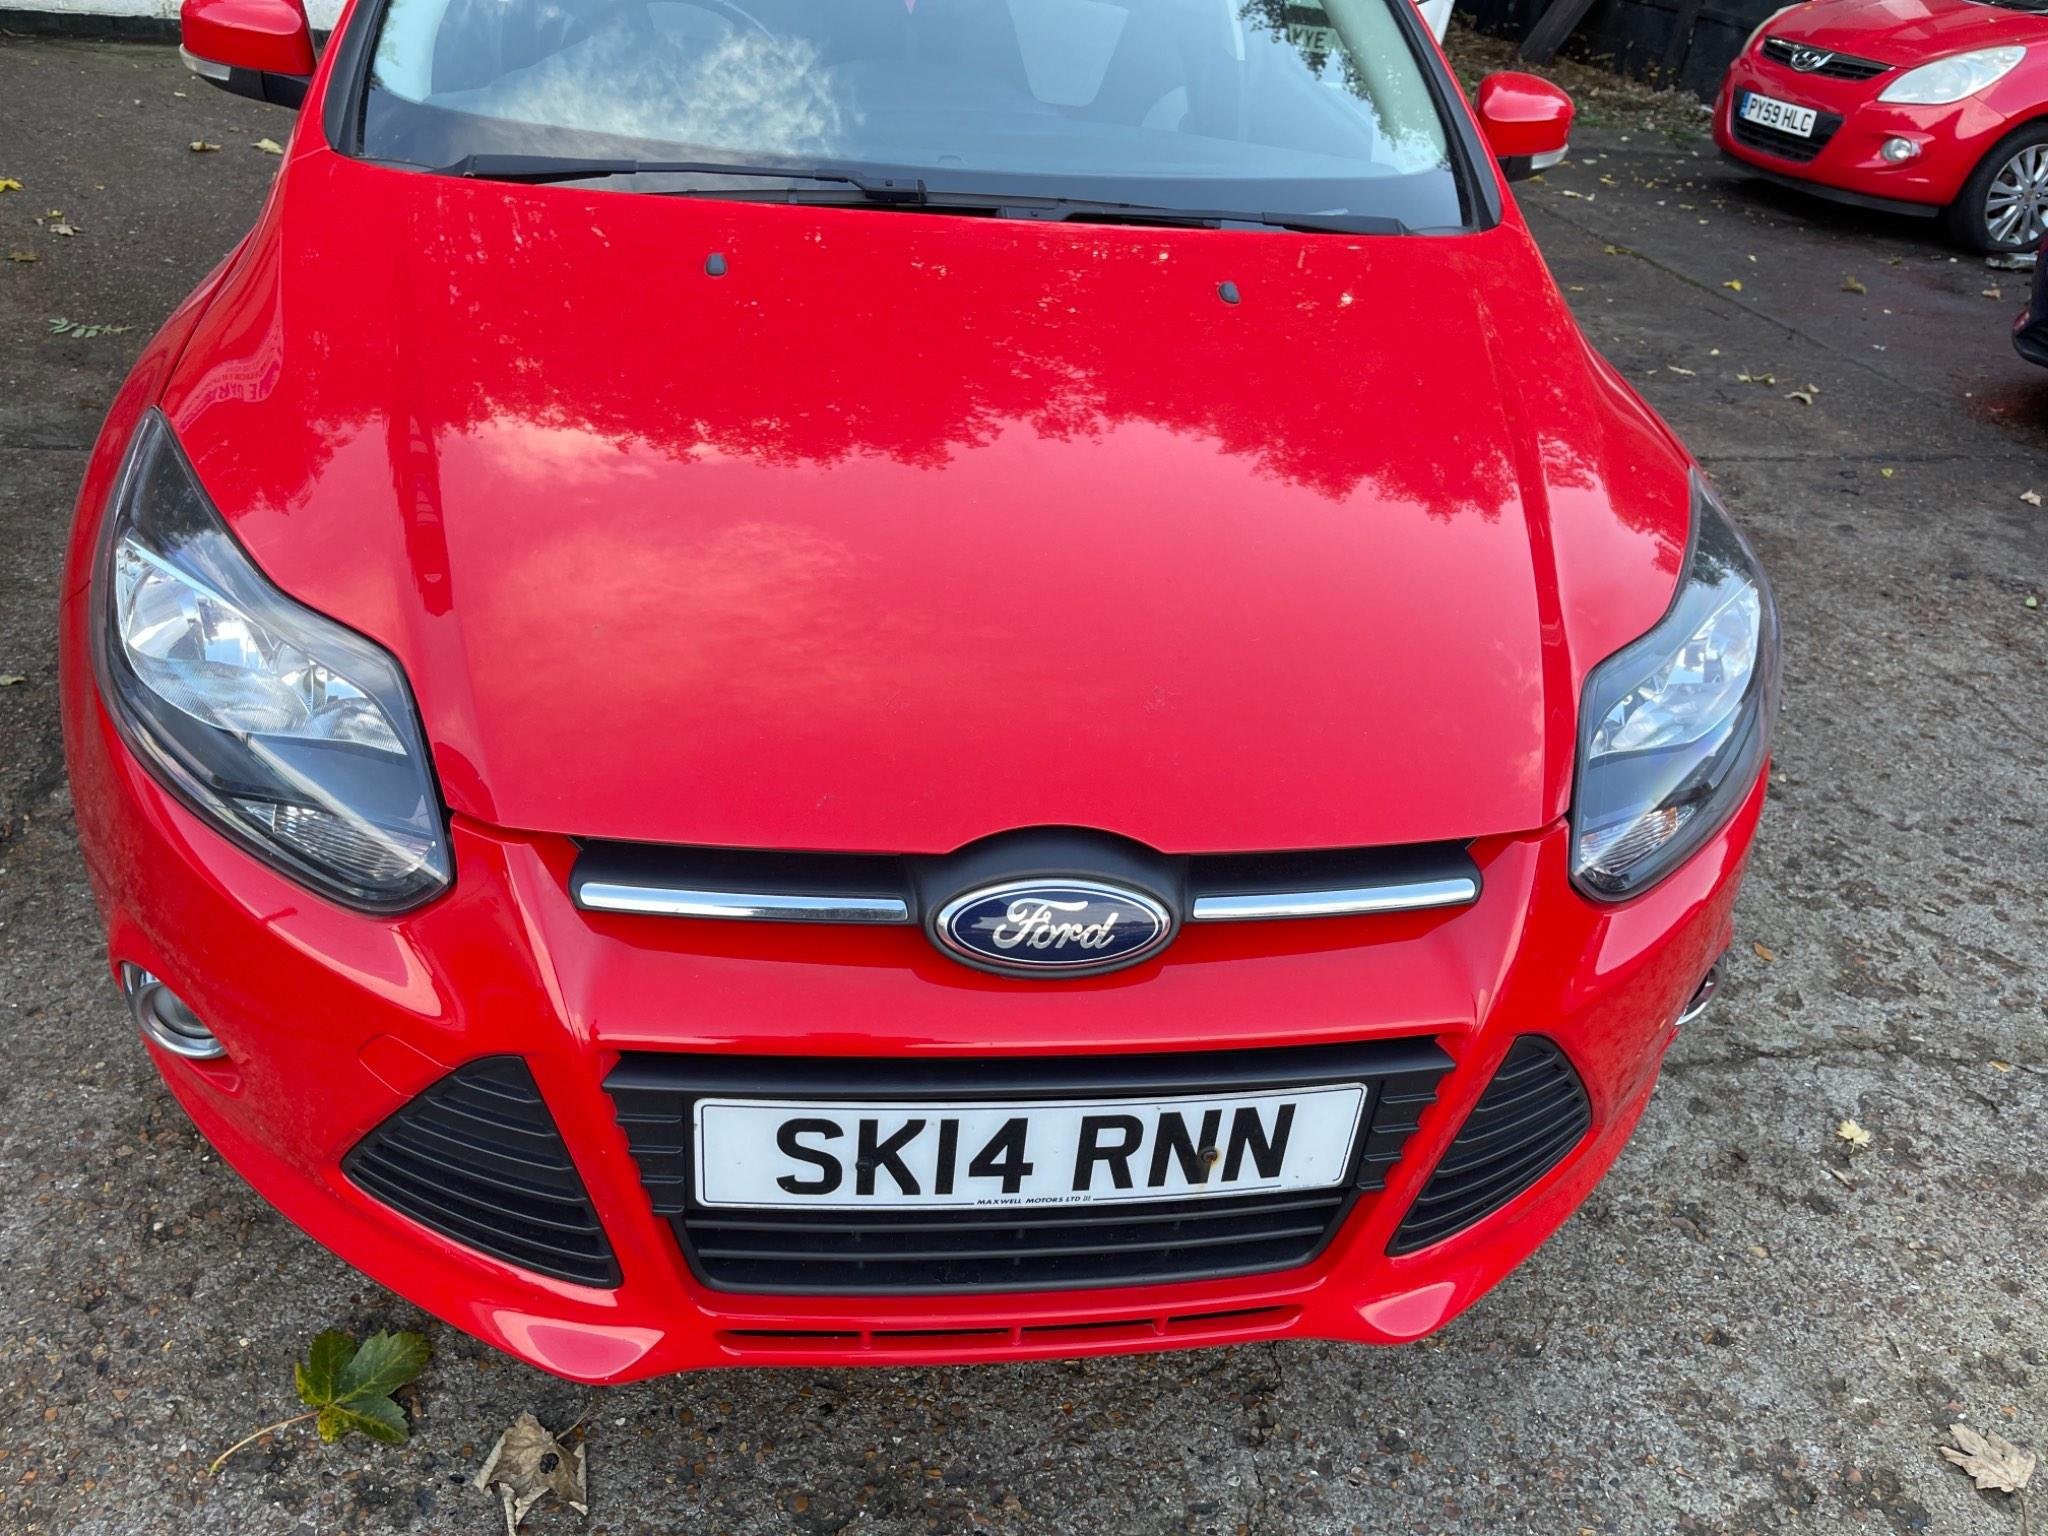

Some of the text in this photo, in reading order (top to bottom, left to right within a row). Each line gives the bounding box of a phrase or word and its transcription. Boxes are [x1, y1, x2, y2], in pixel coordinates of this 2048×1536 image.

[1747, 98, 1812, 132] PY59 HLC
[992, 897, 1119, 949] Ford
[776, 1103, 1297, 1195] SK14 RNN
[1025, 1196, 1063, 1204] MOTORS
[1065, 1195, 1082, 1203] LTD
